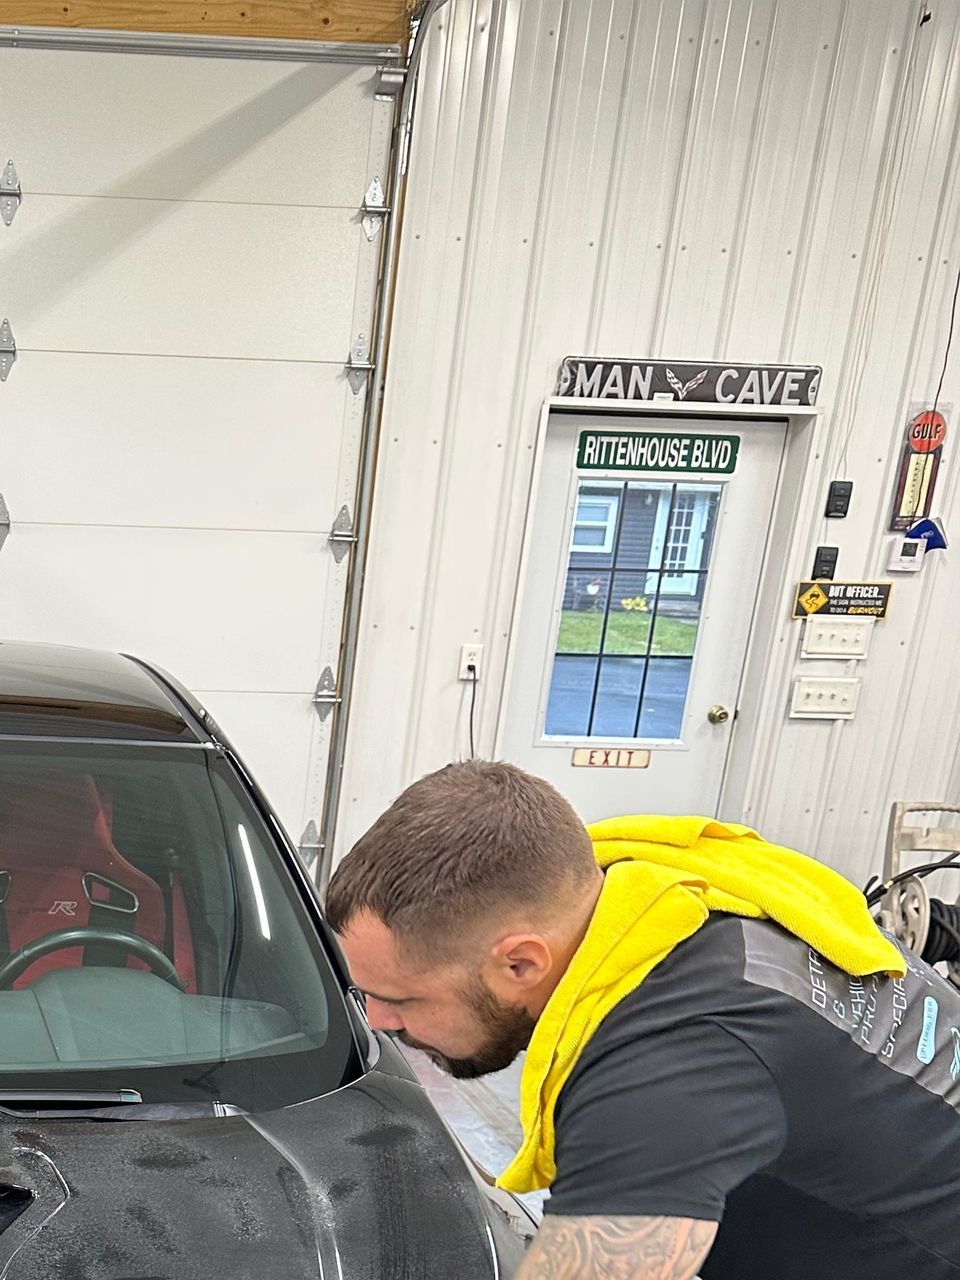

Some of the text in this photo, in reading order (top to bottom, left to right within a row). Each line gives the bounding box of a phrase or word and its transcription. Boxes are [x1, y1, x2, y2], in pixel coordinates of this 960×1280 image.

[573, 363, 806, 406] MAN CAVE
[912, 424, 942, 440] GULF
[583, 435, 732, 470] RITTENHOUSE BLVD
[829, 585, 845, 598] BUT
[847, 606, 885, 615] BURNOUT
[588, 750, 635, 766] EXIT
